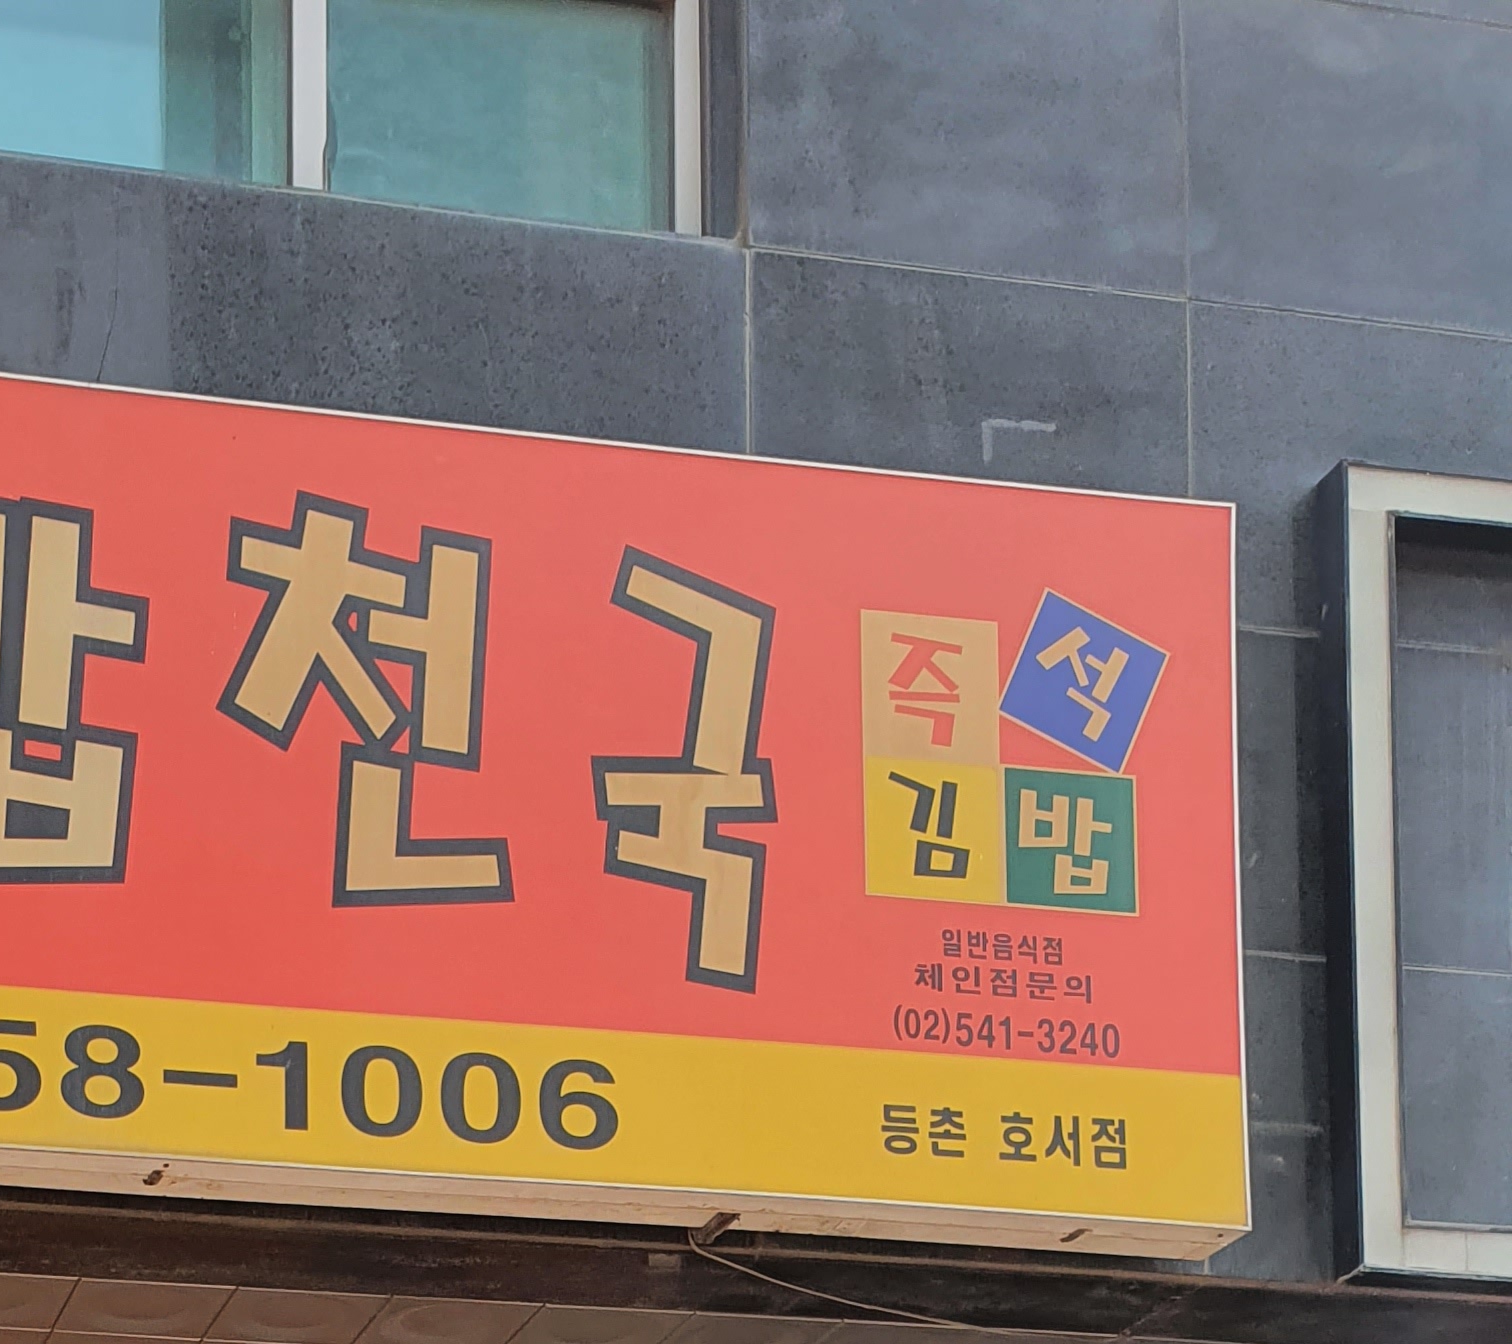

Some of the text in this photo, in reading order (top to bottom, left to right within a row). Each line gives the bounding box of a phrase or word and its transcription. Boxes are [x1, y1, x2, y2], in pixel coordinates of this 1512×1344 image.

[888, 770, 1112, 896] 김밥
[940, 928, 1064, 967] 일반음식점
[913, 961, 1094, 1005] 체인점문의
[892, 1004, 1121, 1059] (02)541-3240
[880, 1103, 1128, 1171] 등촌 호서점
